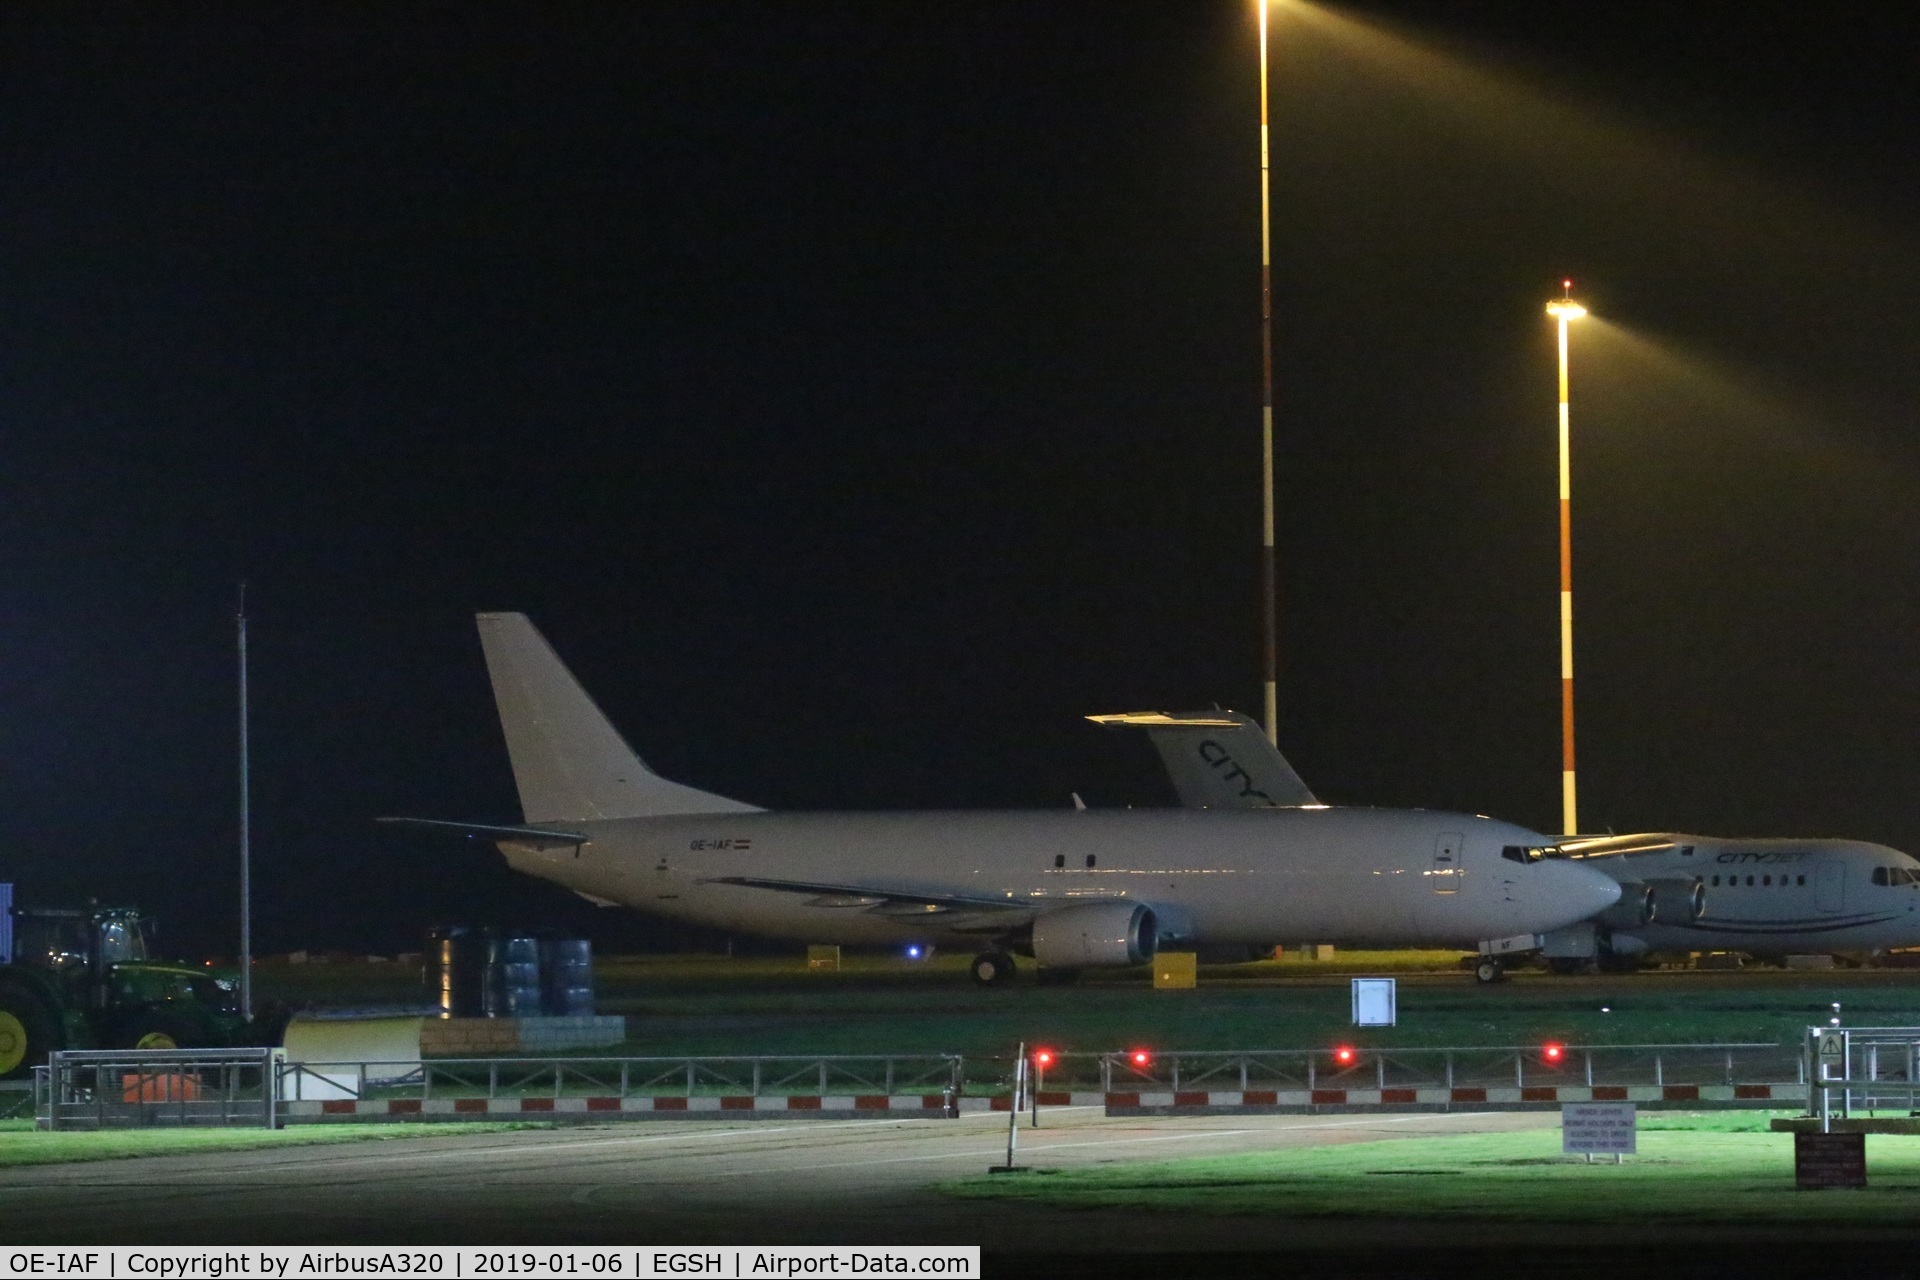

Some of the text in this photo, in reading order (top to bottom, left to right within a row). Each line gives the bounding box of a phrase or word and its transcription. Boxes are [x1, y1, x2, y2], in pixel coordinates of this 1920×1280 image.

[1199, 740, 1276, 806] CITY
[690, 839, 732, 851] OE-IAF
[1716, 852, 1812, 864] CITYJET
